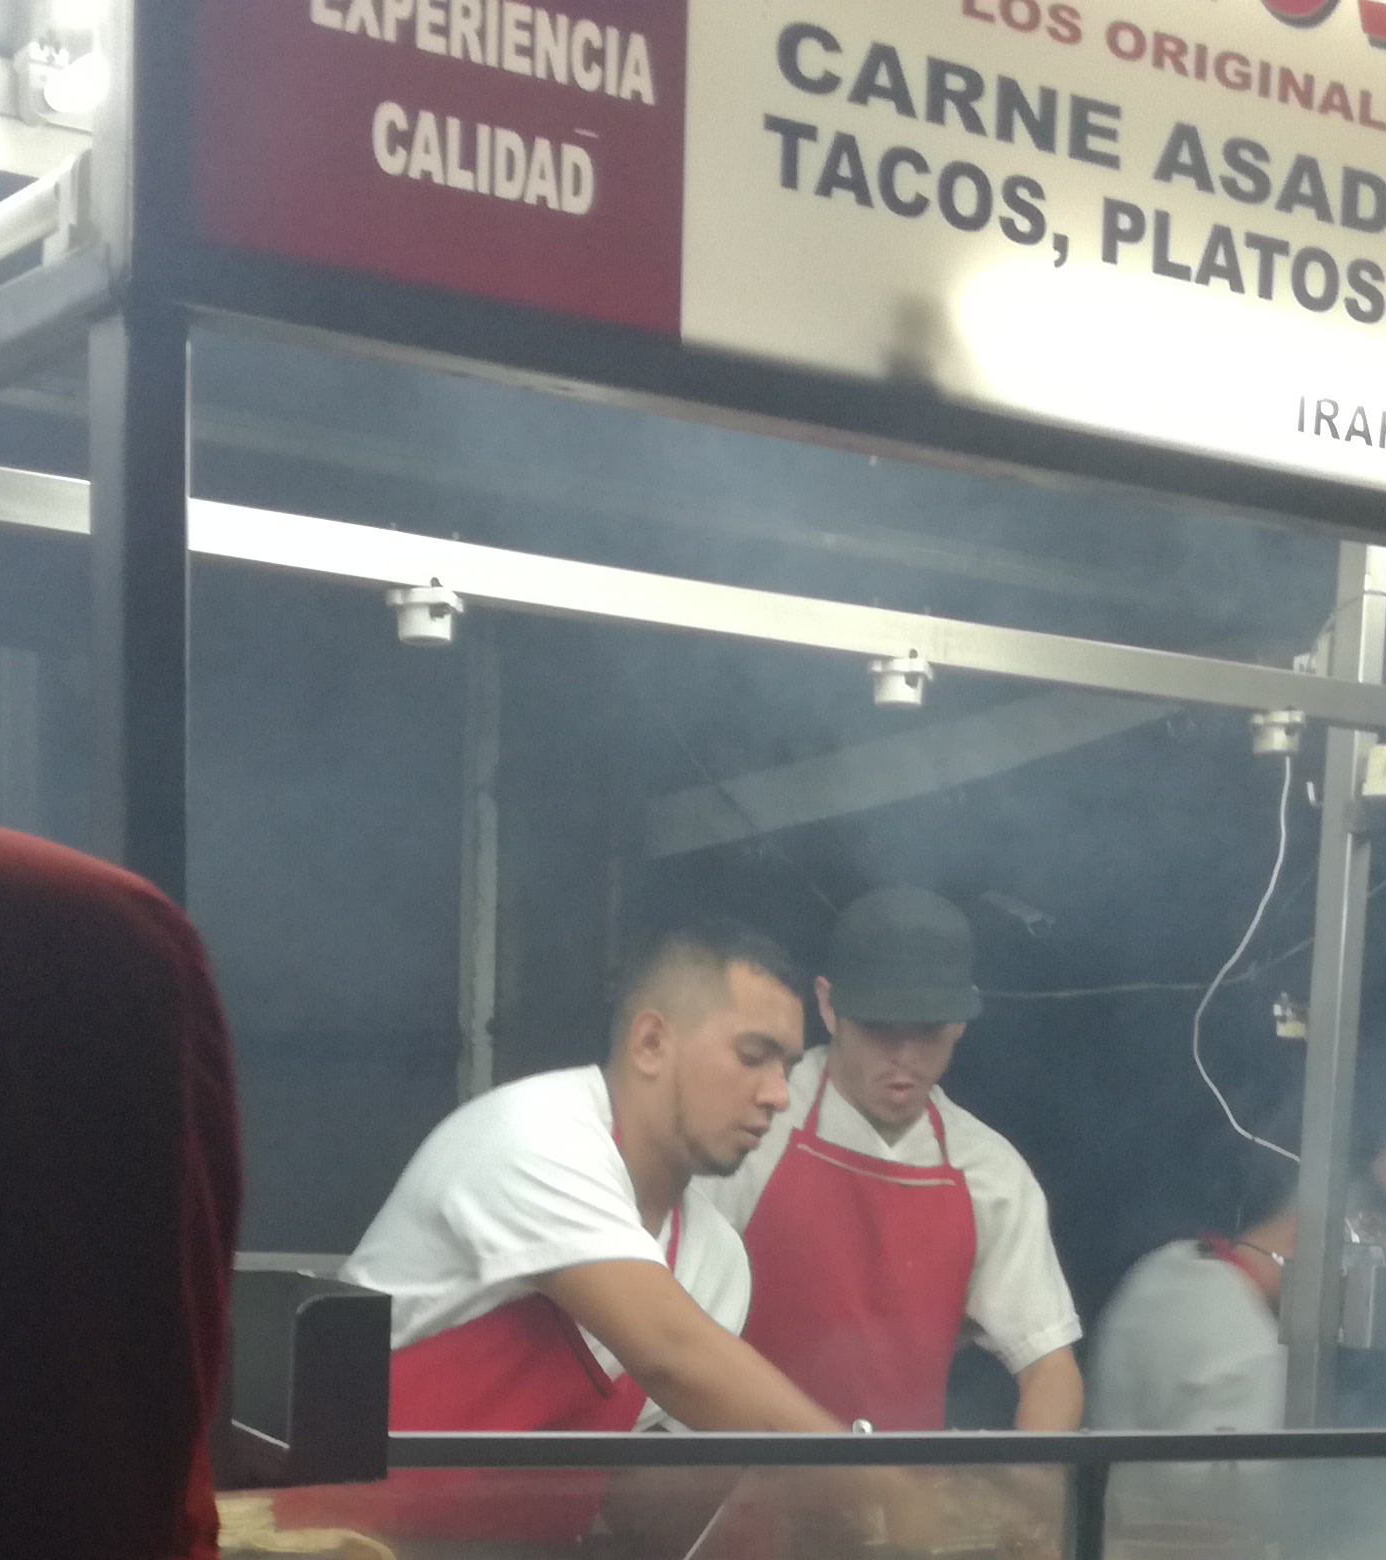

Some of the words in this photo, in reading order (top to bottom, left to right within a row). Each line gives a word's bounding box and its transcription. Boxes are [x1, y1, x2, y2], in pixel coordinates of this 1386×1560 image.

[371, 101, 595, 215] CALIDAD
[776, 21, 1122, 170] CARNE
[763, 114, 1070, 268] TACOS,
